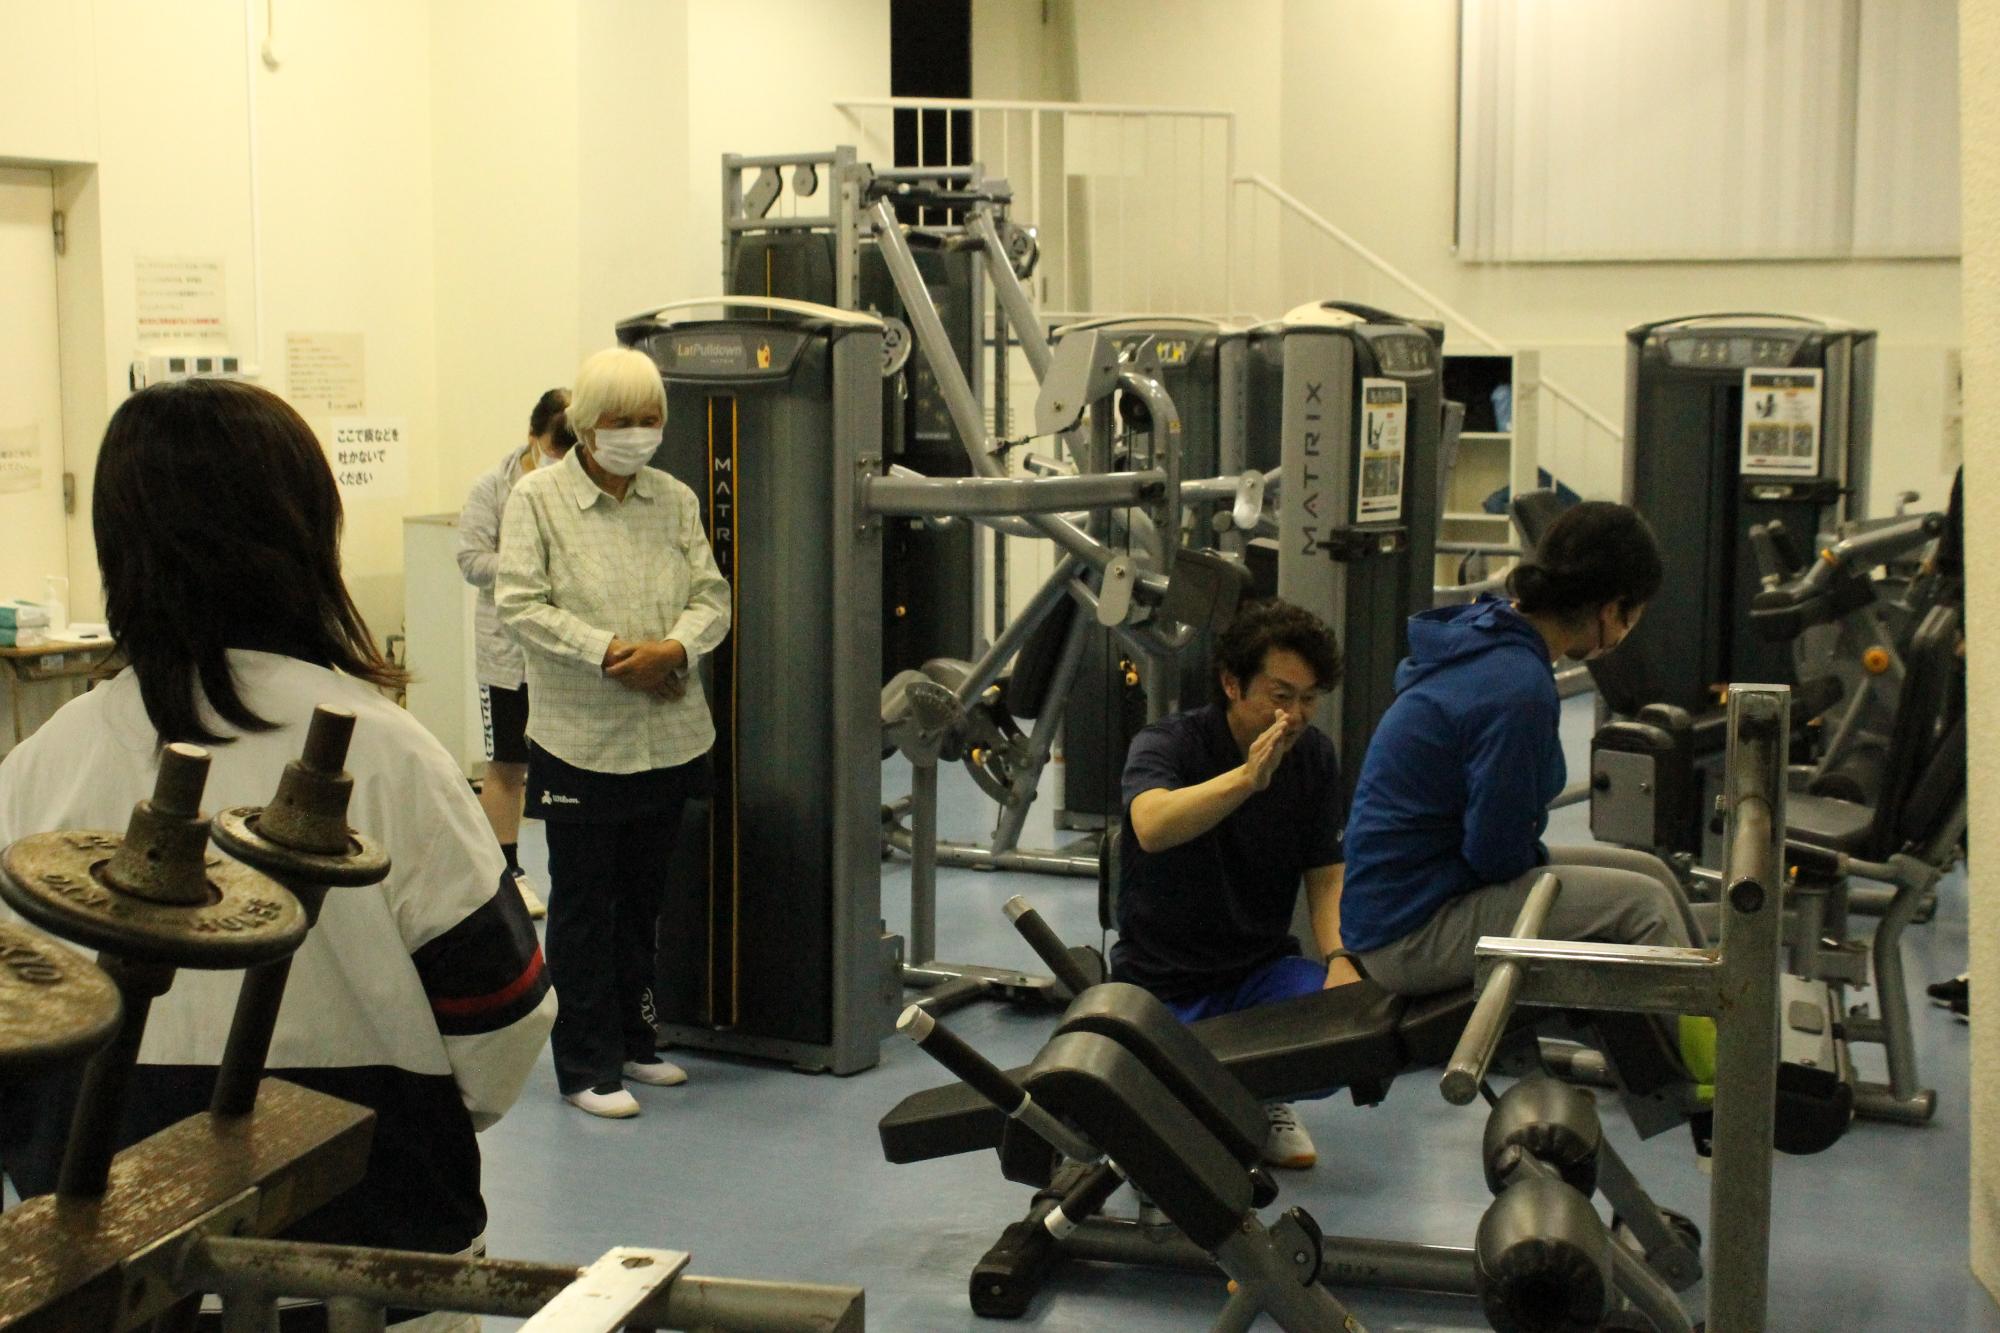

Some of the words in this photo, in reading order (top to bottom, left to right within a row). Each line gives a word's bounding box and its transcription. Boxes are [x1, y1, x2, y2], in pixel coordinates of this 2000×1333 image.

[338, 449, 386, 465] 吐かないで
[338, 471, 374, 486] ください
[1301, 381, 1323, 557] MATRIX
[714, 456, 731, 580] MATRI
